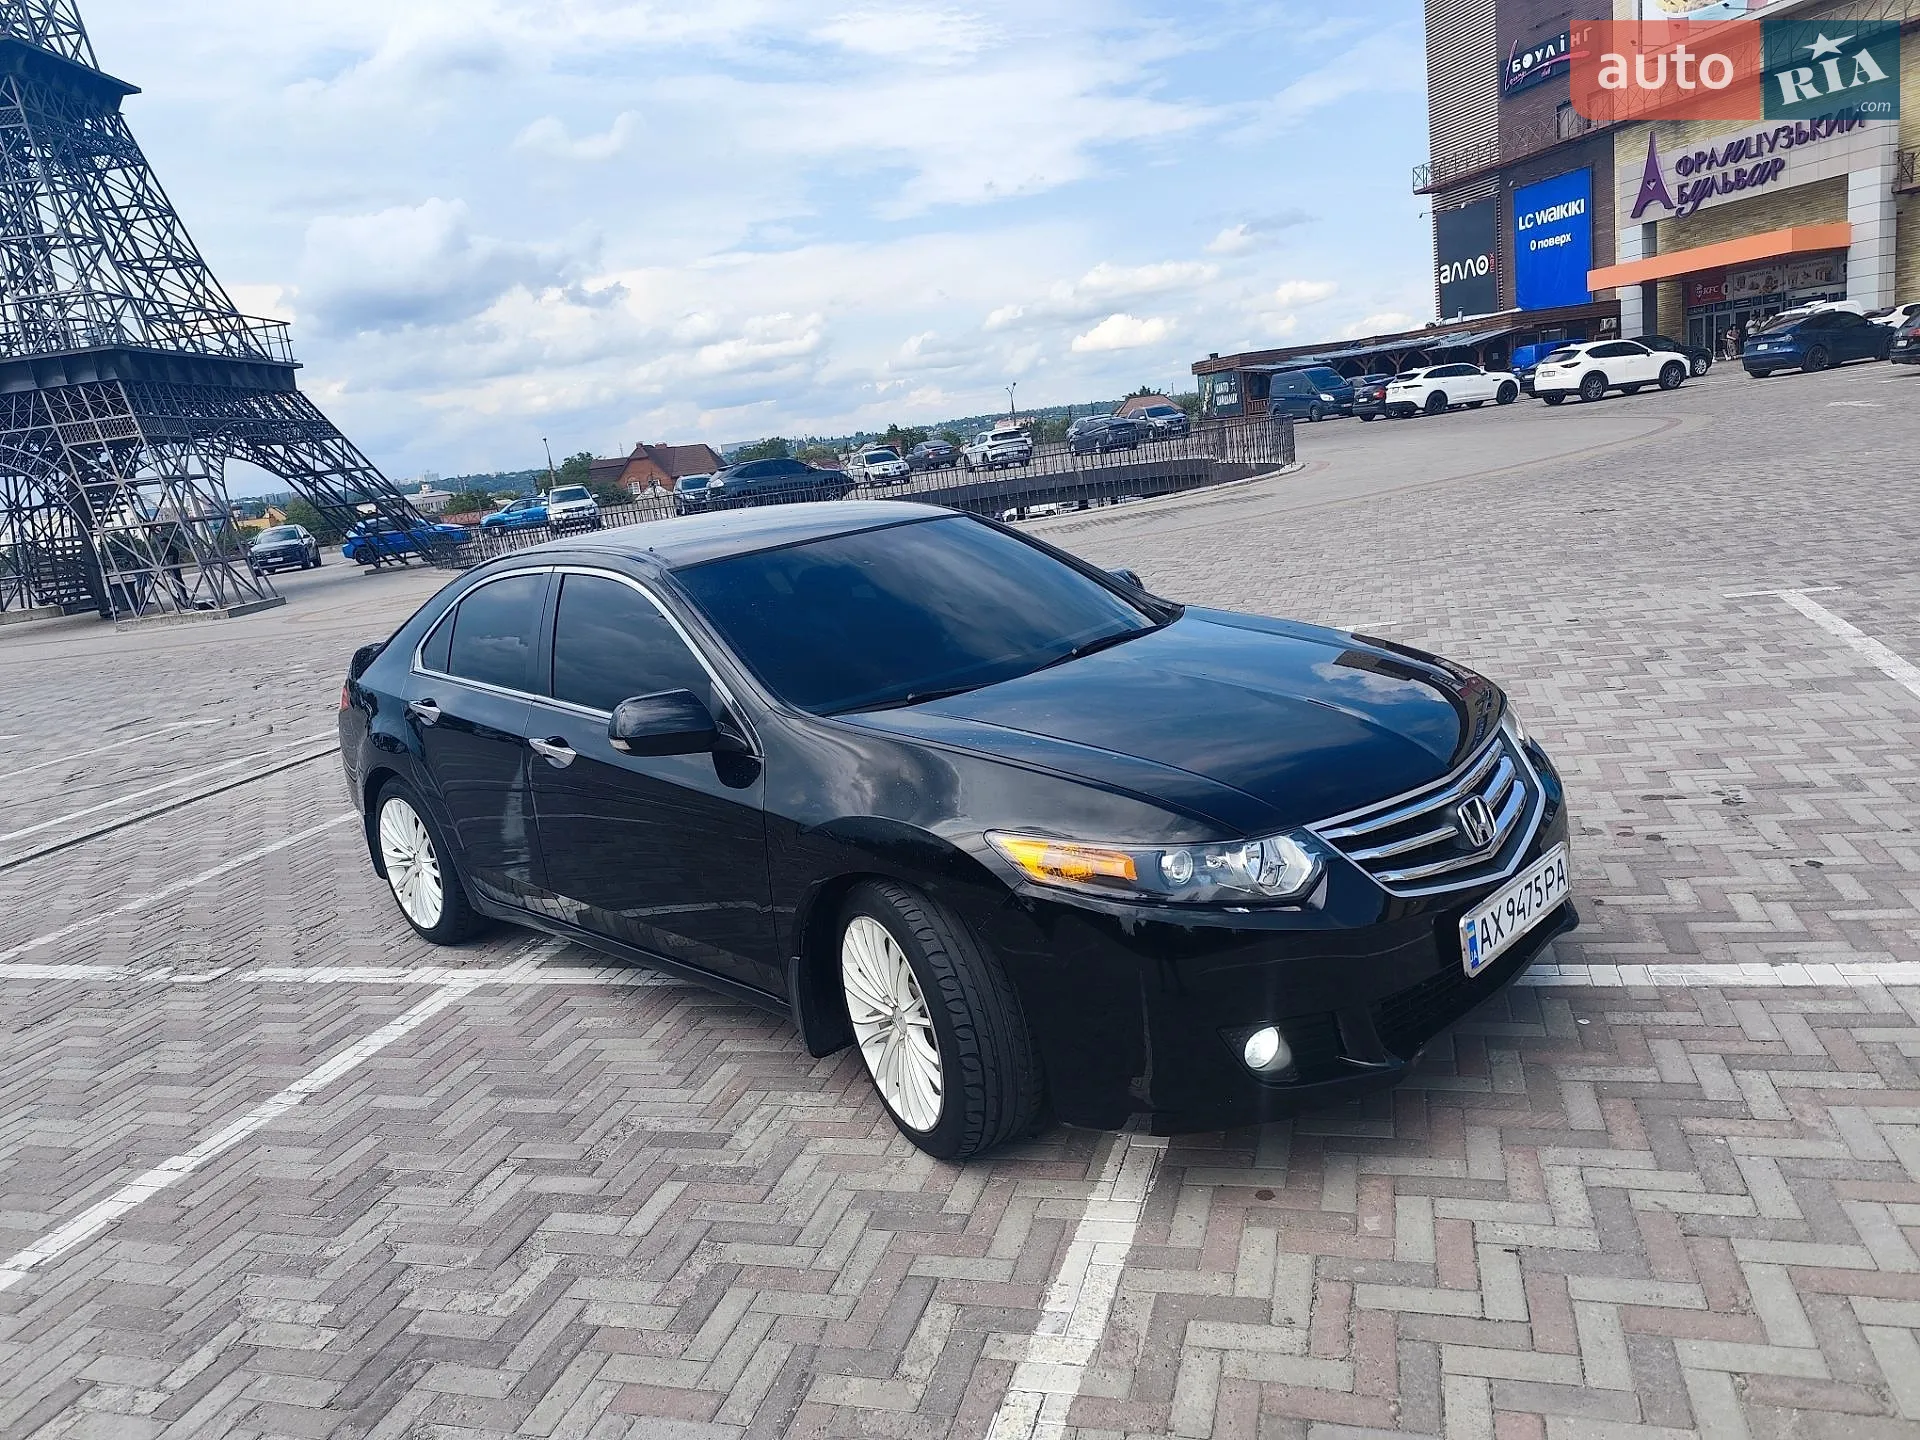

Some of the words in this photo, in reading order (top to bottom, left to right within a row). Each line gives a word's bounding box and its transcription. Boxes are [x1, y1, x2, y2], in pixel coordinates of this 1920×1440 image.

[1518, 213, 1534, 231] LC
[1537, 232, 1572, 250] поверх
[1703, 285, 1719, 295] KFC
